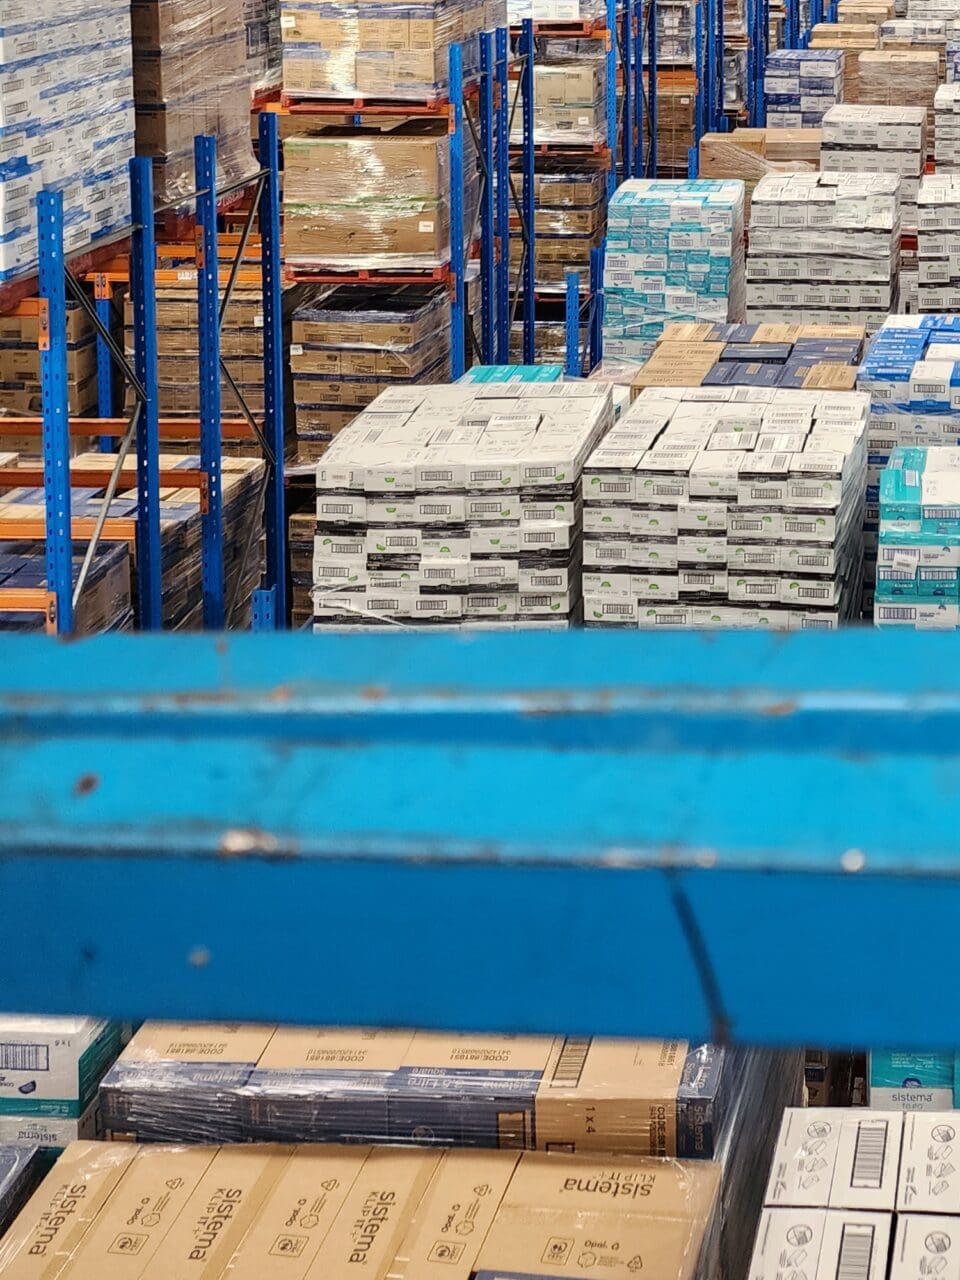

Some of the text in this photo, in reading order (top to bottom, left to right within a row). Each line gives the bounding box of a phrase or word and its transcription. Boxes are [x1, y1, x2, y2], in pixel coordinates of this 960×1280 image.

[891, 1093, 933, 1103] sistema
[18, 1131, 58, 1142] sistema
[559, 1177, 654, 1198] sistema
[624, 1173, 656, 1183] KLIP
[205, 1188, 227, 1214] KLIP
[361, 1191, 379, 1217] KLIP
[28, 1183, 87, 1258] sistema
[188, 1188, 243, 1262] sistema
[348, 1191, 396, 1265] sistema
